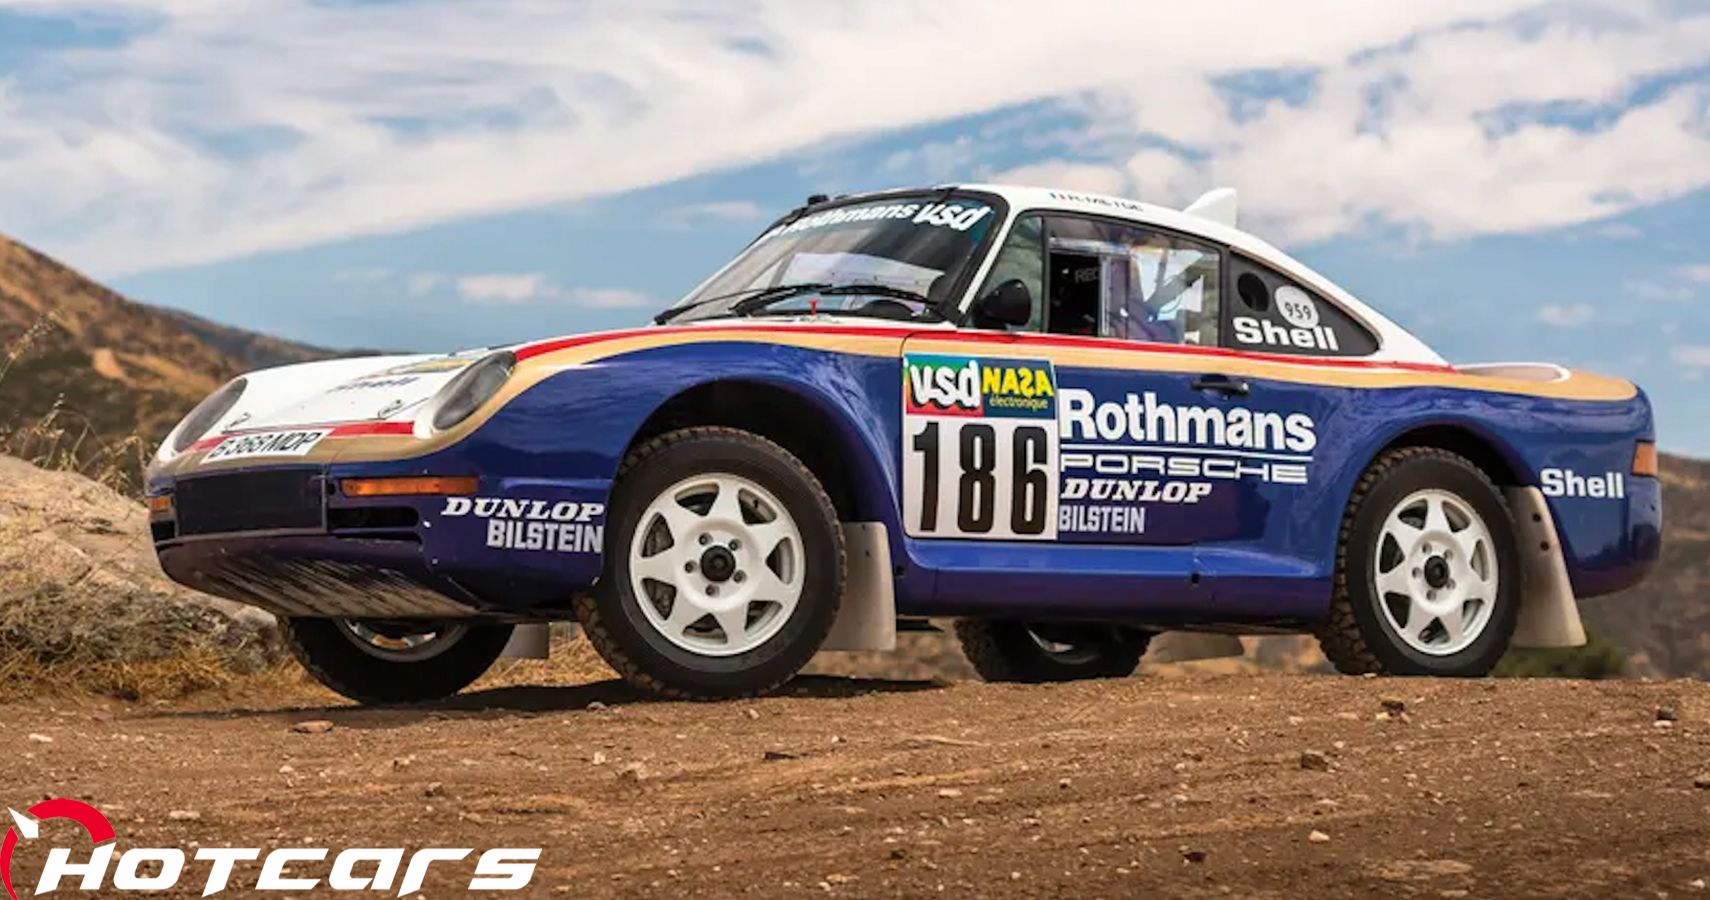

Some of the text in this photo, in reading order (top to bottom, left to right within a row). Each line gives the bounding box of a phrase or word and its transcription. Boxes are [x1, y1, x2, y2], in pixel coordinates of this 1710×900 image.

[1284, 301, 1312, 320] 959
[1233, 316, 1339, 351] Shell
[904, 358, 981, 407] vsd
[1058, 388, 1317, 452] Rothmans
[913, 421, 1047, 534] 186
[1060, 454, 1308, 484] PORSCHE
[1540, 467, 1624, 499] Shell
[1060, 478, 1212, 503] DUNLOP
[440, 497, 604, 521] DUNLOP
[1058, 505, 1146, 533] BILSTEIN
[486, 519, 604, 553] BILSTEIN
